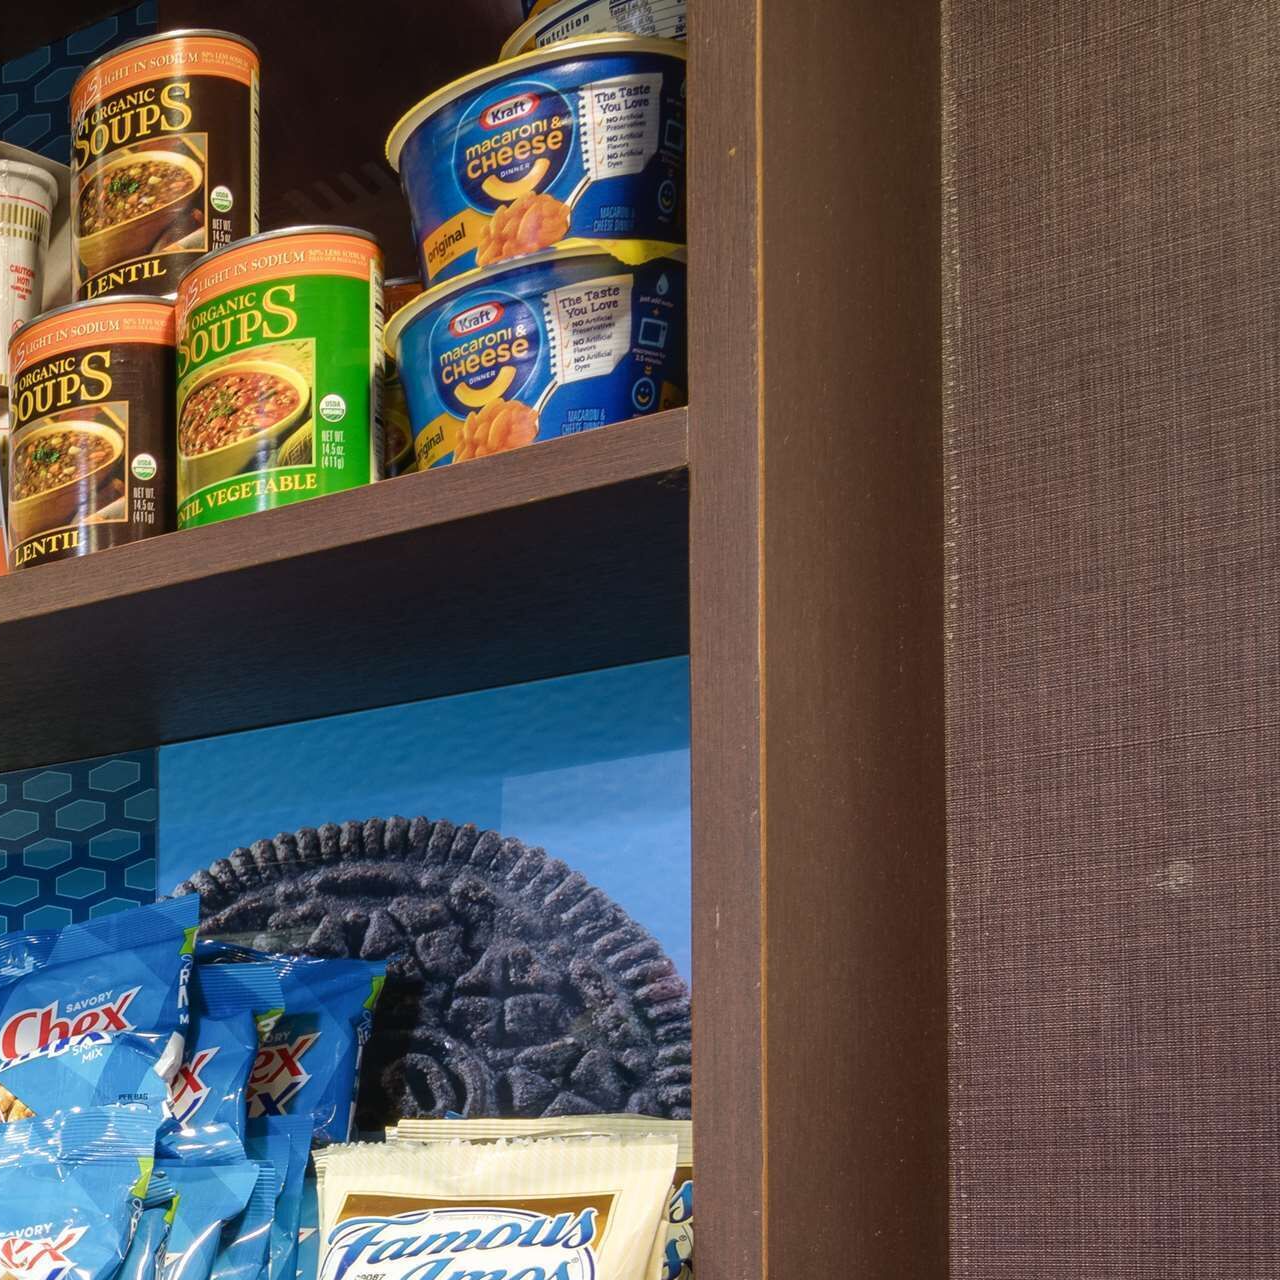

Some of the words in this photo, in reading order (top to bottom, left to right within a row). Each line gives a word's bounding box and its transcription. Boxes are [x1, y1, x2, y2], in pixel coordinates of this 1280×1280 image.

[595, 90, 616, 104] The
[618, 84, 651, 100] Taste
[600, 102, 622, 114] You
[624, 98, 650, 110] Love
[73, 82, 192, 170] SOUPS
[466, 118, 548, 161] macaroni
[550, 115, 561, 128] &
[500, 162, 530, 178] DINNER
[428, 222, 466, 264] original
[87, 259, 167, 299] LENTIL
[199, 268, 231, 291] LIGHT
[234, 262, 248, 275] IN
[251, 250, 305, 271] SODIUM
[191, 291, 256, 330] ORGANIC
[559, 295, 583, 310] The
[586, 287, 620, 303] Taste
[566, 306, 588, 319] You
[591, 299, 618, 314] Love
[459, 311, 491, 331] Kraft
[26, 334, 53, 355] LIGHT
[56, 330, 68, 342] IN
[70, 319, 120, 337] SODIUM
[573, 339, 584, 347] NO
[585, 334, 613, 344] Artificial
[469, 370, 496, 385] DINNER
[177, 502, 203, 529] NTIL
[207, 473, 317, 508] VEGETABLE
[65, 990, 113, 1014] SAVORY
[2, 991, 134, 1062] Chex
